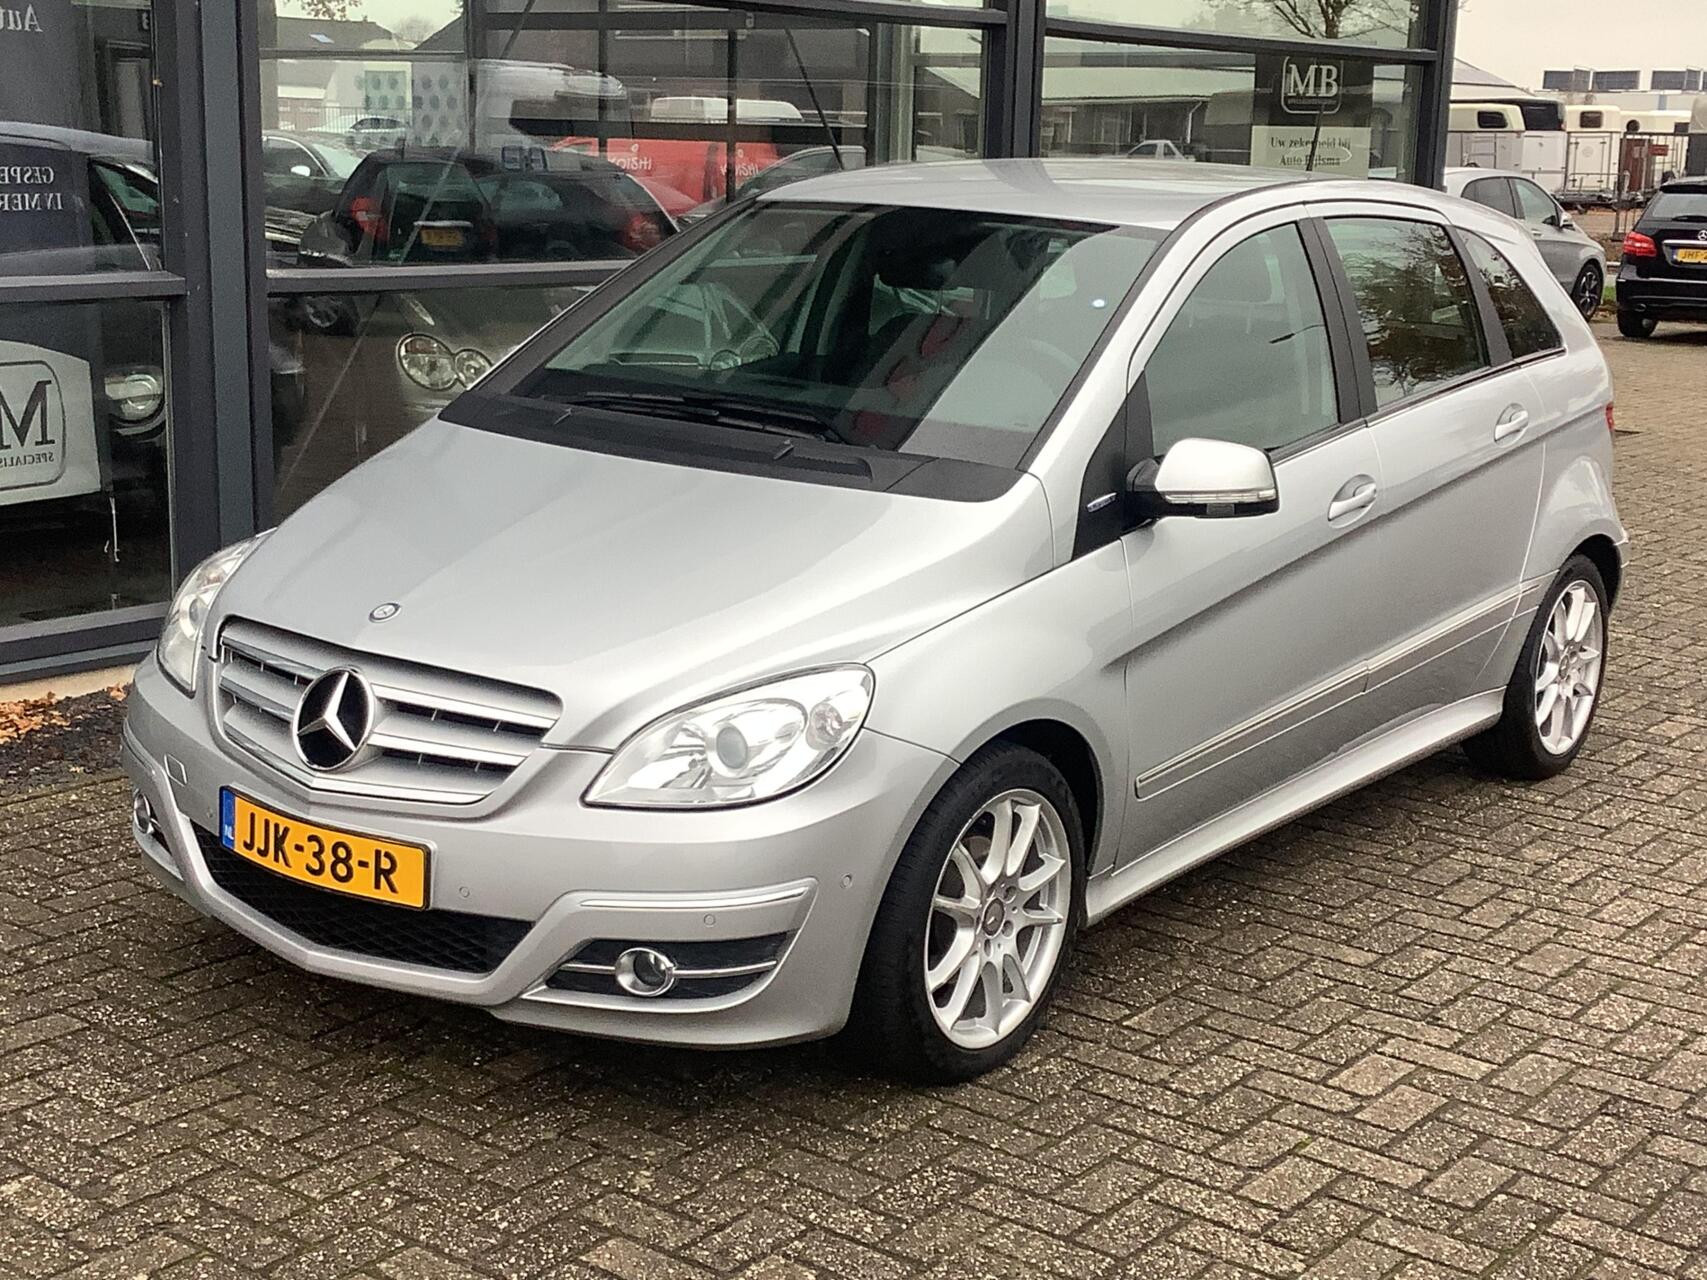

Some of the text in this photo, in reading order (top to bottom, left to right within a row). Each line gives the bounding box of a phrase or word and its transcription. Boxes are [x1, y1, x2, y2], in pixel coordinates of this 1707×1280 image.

[1287, 63, 1339, 97] MB
[1279, 155, 1302, 167] Auto
[224, 812, 399, 894] NL JJK-38-R
